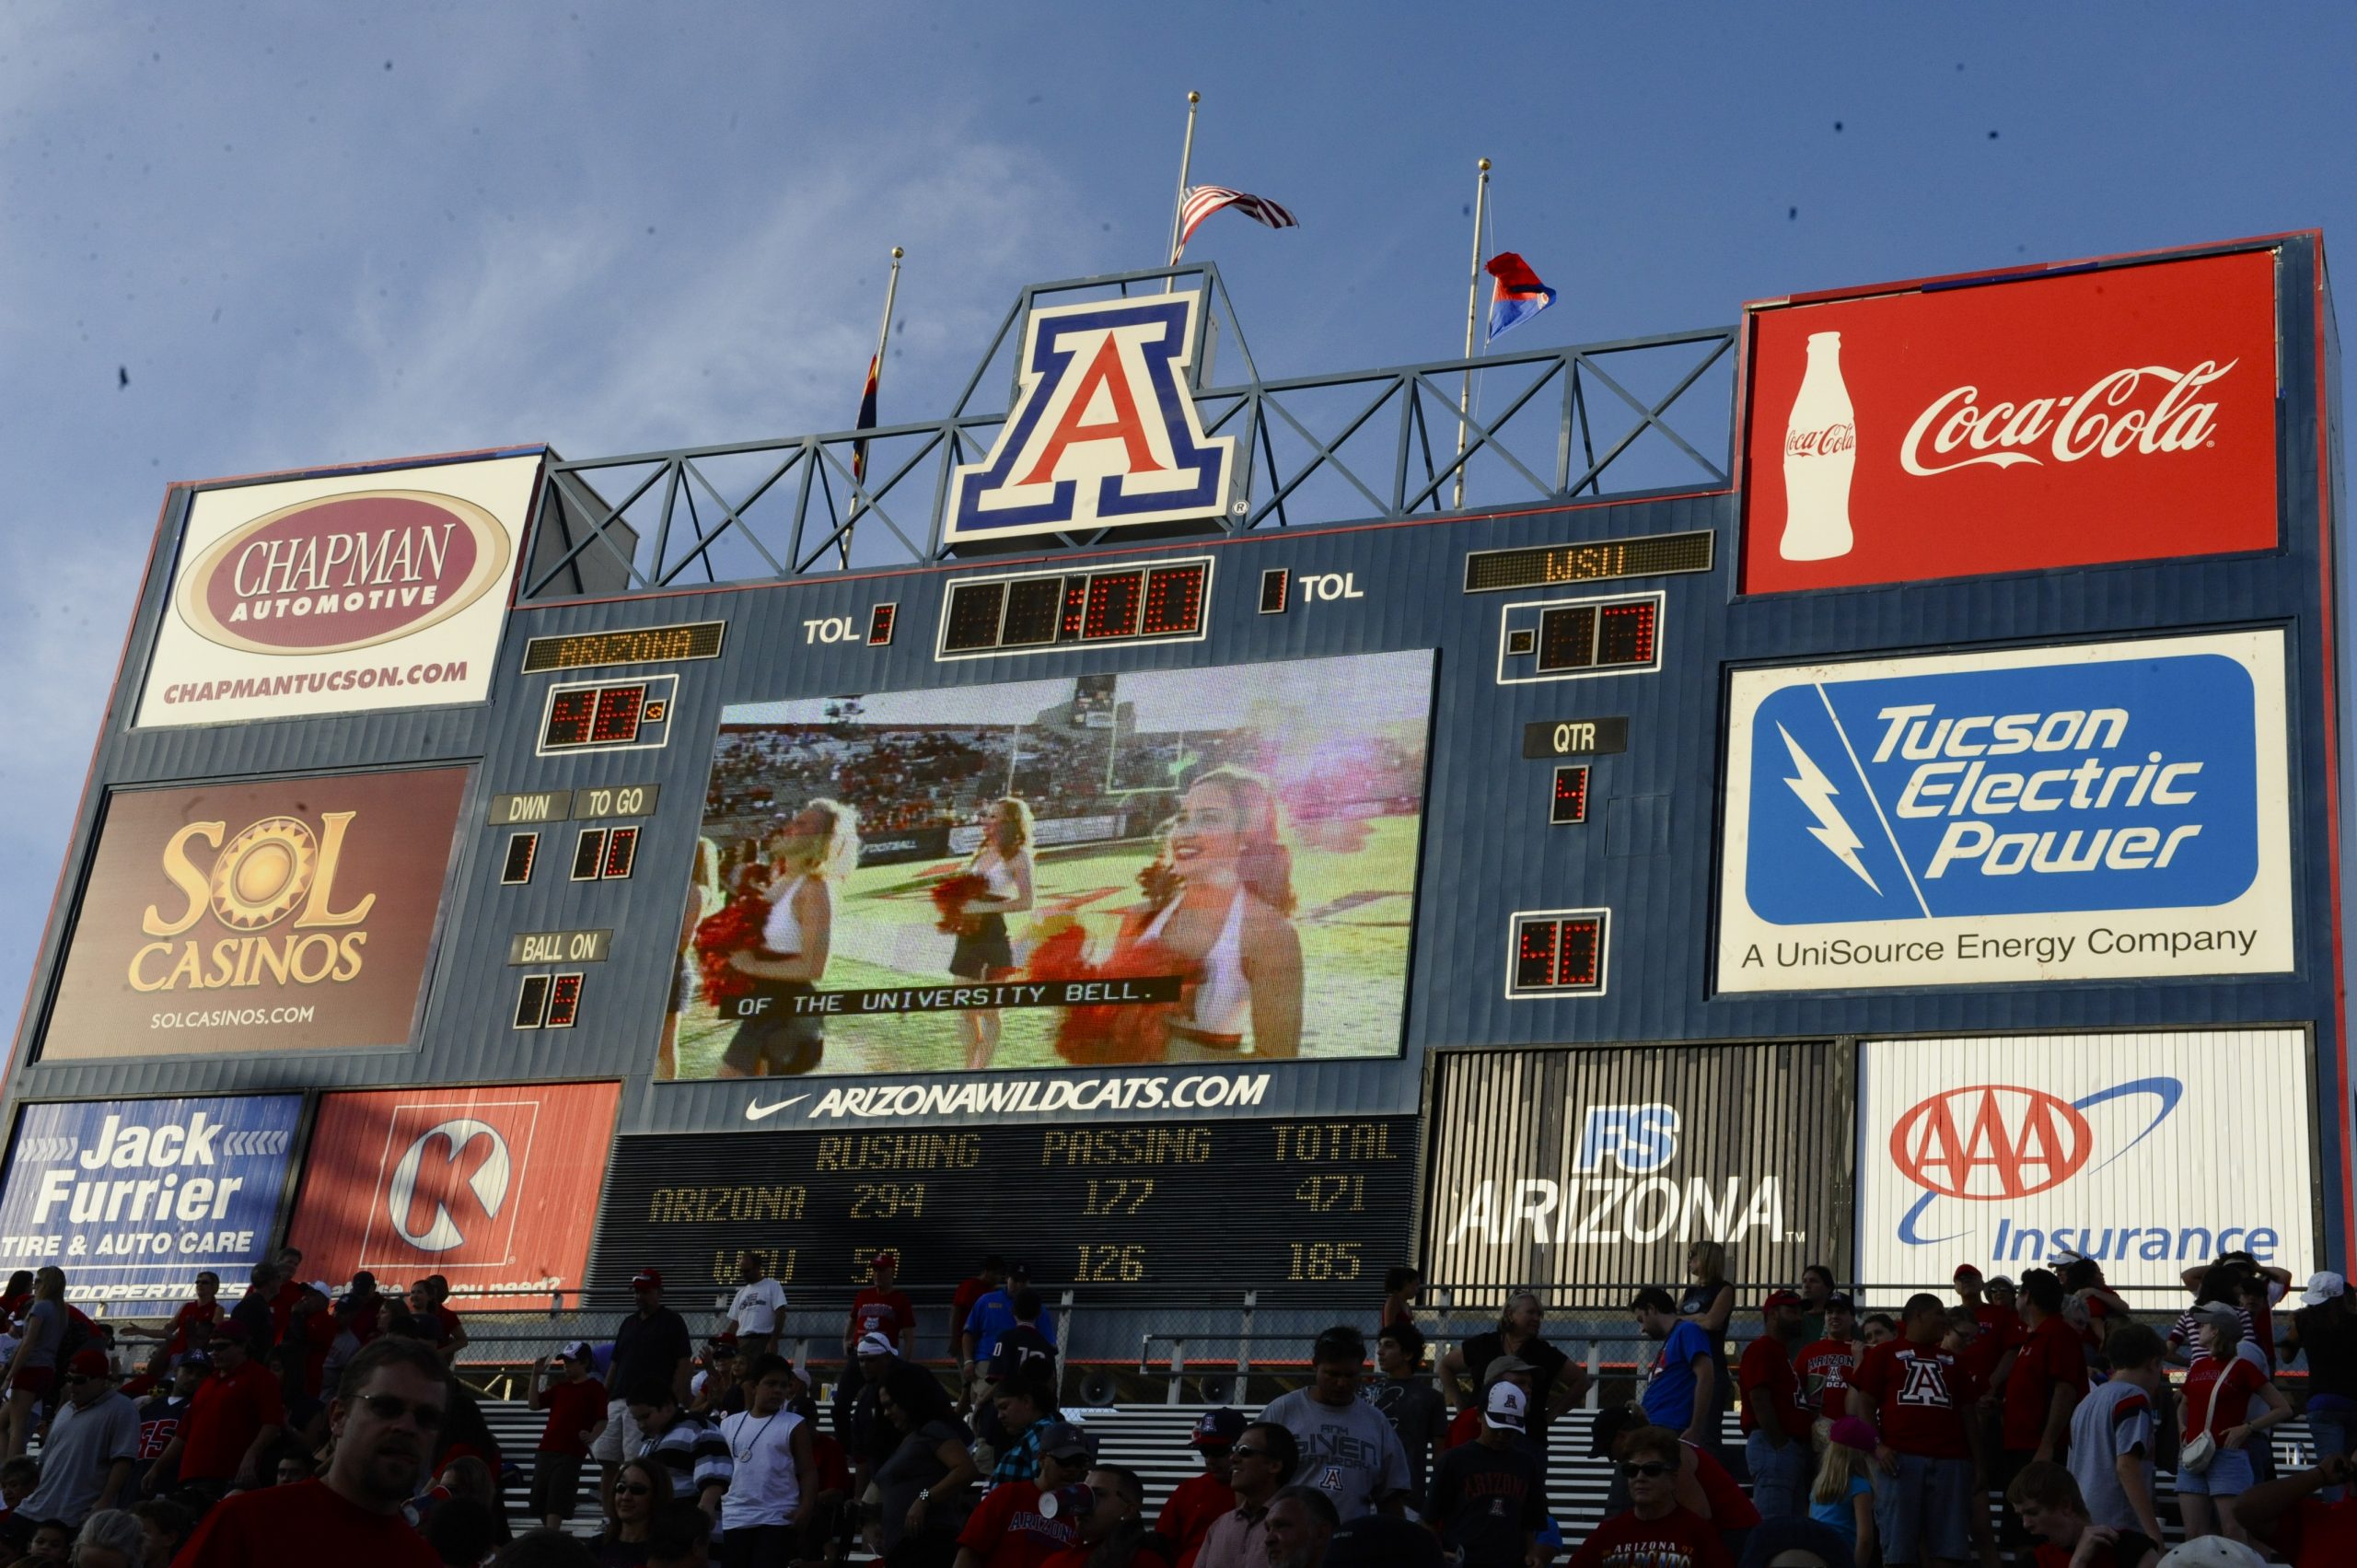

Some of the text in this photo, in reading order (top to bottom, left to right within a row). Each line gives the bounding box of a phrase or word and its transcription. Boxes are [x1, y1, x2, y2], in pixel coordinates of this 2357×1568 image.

[945, 290, 1235, 543] A
[1900, 357, 2238, 476] Coca-Cola
[1786, 423, 1854, 457] Coca-Cola
[234, 523, 456, 598] CHAPMAN
[1545, 545, 1625, 584] WSU
[229, 585, 438, 622] AUTOMOTIVE
[1299, 573, 1364, 603] TOL
[558, 629, 691, 668] ARIZONA
[803, 616, 861, 645] TOL
[163, 660, 468, 704] CHAPMANTUCSON.COM
[1552, 723, 1596, 753] QTR
[1871, 703, 2129, 763] Tucson
[589, 787, 644, 816] TO GO
[1896, 751, 2204, 819] Electric
[508, 796, 551, 821] DWN
[1923, 819, 2203, 879] Power
[142, 810, 377, 936] SOL
[128, 930, 368, 993] CASINOS
[521, 933, 598, 962] BALL ON
[1741, 925, 2258, 970] A UniSource Energy Company
[150, 1005, 315, 1029] SOLCASINOS.COM
[737, 981, 1154, 1016] OF THE UNIVERSITY BELL.
[808, 1074, 1271, 1119] ARIZONAWILDCATS.COM
[80, 1112, 224, 1169] Jack
[816, 1122, 1399, 1171] RUSHING PASSING TOTAL
[1573, 1102, 1681, 1175] FS
[1914, 1086, 2070, 1197] AAA
[32, 1168, 243, 1225] Furrier
[648, 1174, 1366, 1223] ARIZONA 294 177 471
[1447, 1175, 1784, 1245] ARIZONA
[0, 1231, 254, 1258] TIRE & AUTO CARE
[1074, 1245, 1146, 1282] 126
[1287, 1242, 1363, 1281] 185
[1991, 1218, 2280, 1262] Insurance
[1897, 1357, 1954, 1411] A
[1613, 1540, 1677, 1552] ARIZONA
